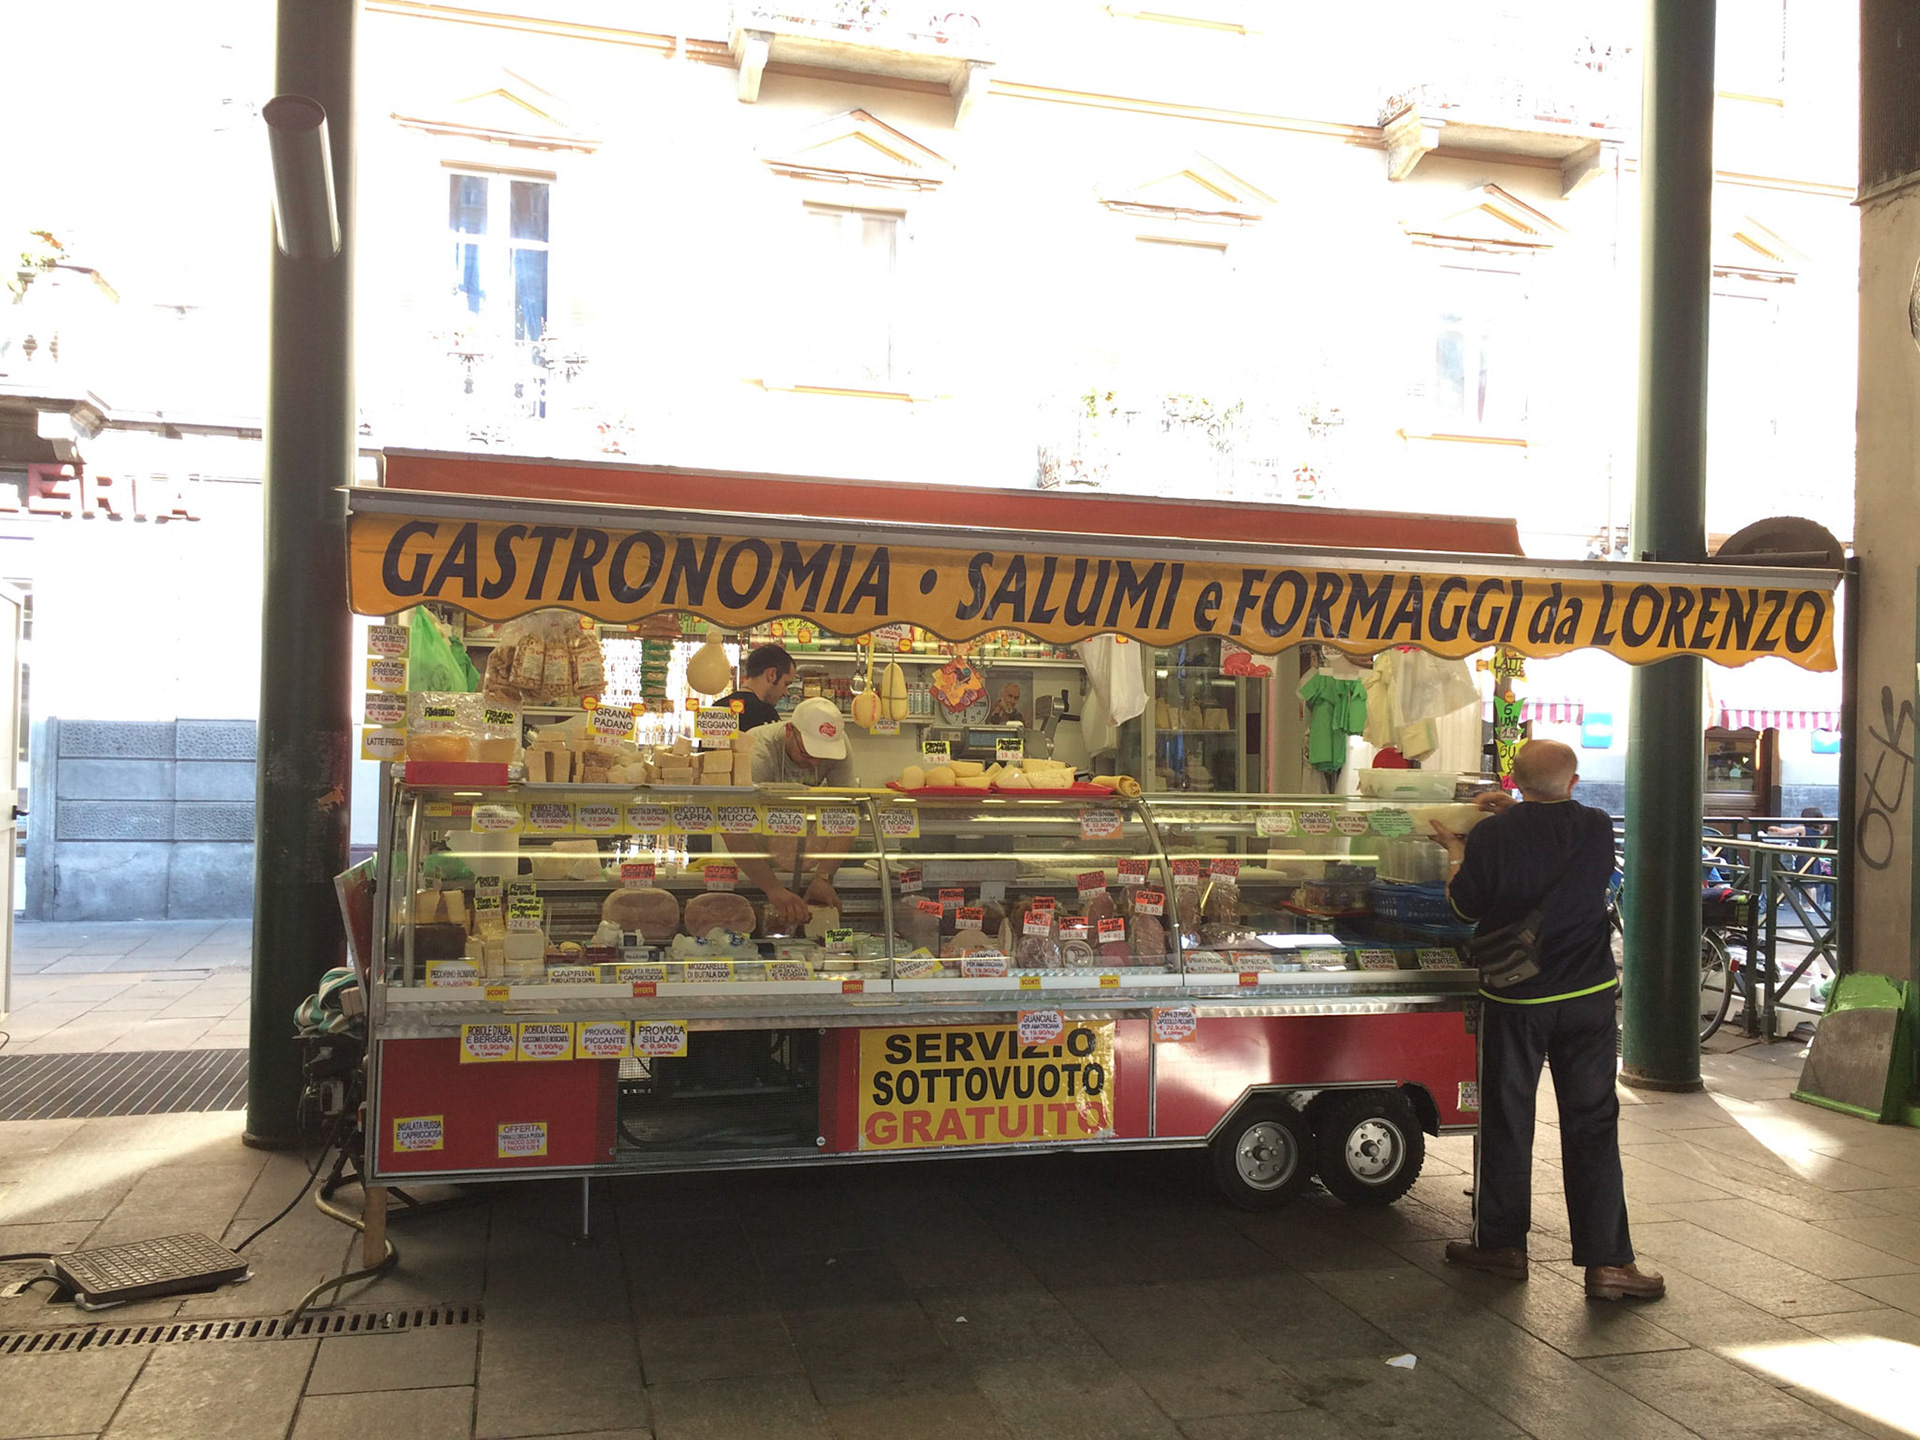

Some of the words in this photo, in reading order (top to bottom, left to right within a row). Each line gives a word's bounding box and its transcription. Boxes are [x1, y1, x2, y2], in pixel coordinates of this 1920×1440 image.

[0, 463, 200, 522] ERIA
[381, 521, 892, 618] GASTRONOMIA
[957, 552, 1183, 632] SALUMI
[1194, 584, 1223, 632] e
[1234, 570, 1525, 644] FORMAGGI
[1528, 582, 1583, 646] da
[1590, 583, 1826, 654] LORENZO
[1493, 657, 1526, 670] LATTE
[1503, 703, 1513, 716] 6
[596, 708, 632, 721] GRANA
[696, 711, 738, 720] PARMIGIANO
[593, 717, 634, 731] PADANO
[696, 720, 738, 730] REGGIANO
[366, 737, 386, 746] LATTE
[580, 807, 619, 815] PRIMOSALE
[674, 806, 712, 814] RICOTTA
[717, 806, 756, 814] RICOTTA
[536, 811, 571, 819] BERGERA
[674, 813, 713, 821] CAPRA
[717, 813, 760, 822] MUCCA
[430, 969, 456, 979] PECORINO
[457, 969, 479, 978] ROMANO
[552, 970, 595, 978] CAPRINI
[717, 970, 730, 978] DOP
[1021, 978, 1040, 986] SCONTI
[486, 989, 509, 997] SCONTI
[1023, 1014, 1057, 1024] GUANCIALE
[468, 1026, 492, 1036] ROBIOLE
[493, 1026, 512, 1035] D'ALBA
[525, 1026, 548, 1035] ROBIOLA
[549, 1025, 569, 1034] OSELLA
[638, 1026, 685, 1035] PROVOLA
[466, 1036, 472, 1044] E
[584, 1036, 626, 1044] PICCANTE
[642, 1035, 680, 1043] SILANA
[873, 1062, 1106, 1106] SOTTOVUOTO
[398, 1121, 423, 1131] INSALATA
[424, 1120, 442, 1129] RUSSA
[865, 1101, 1112, 1146] GRATUITO
[504, 1124, 541, 1133] OFFERTA
[402, 1130, 442, 1140] CAPRICCIOSA
